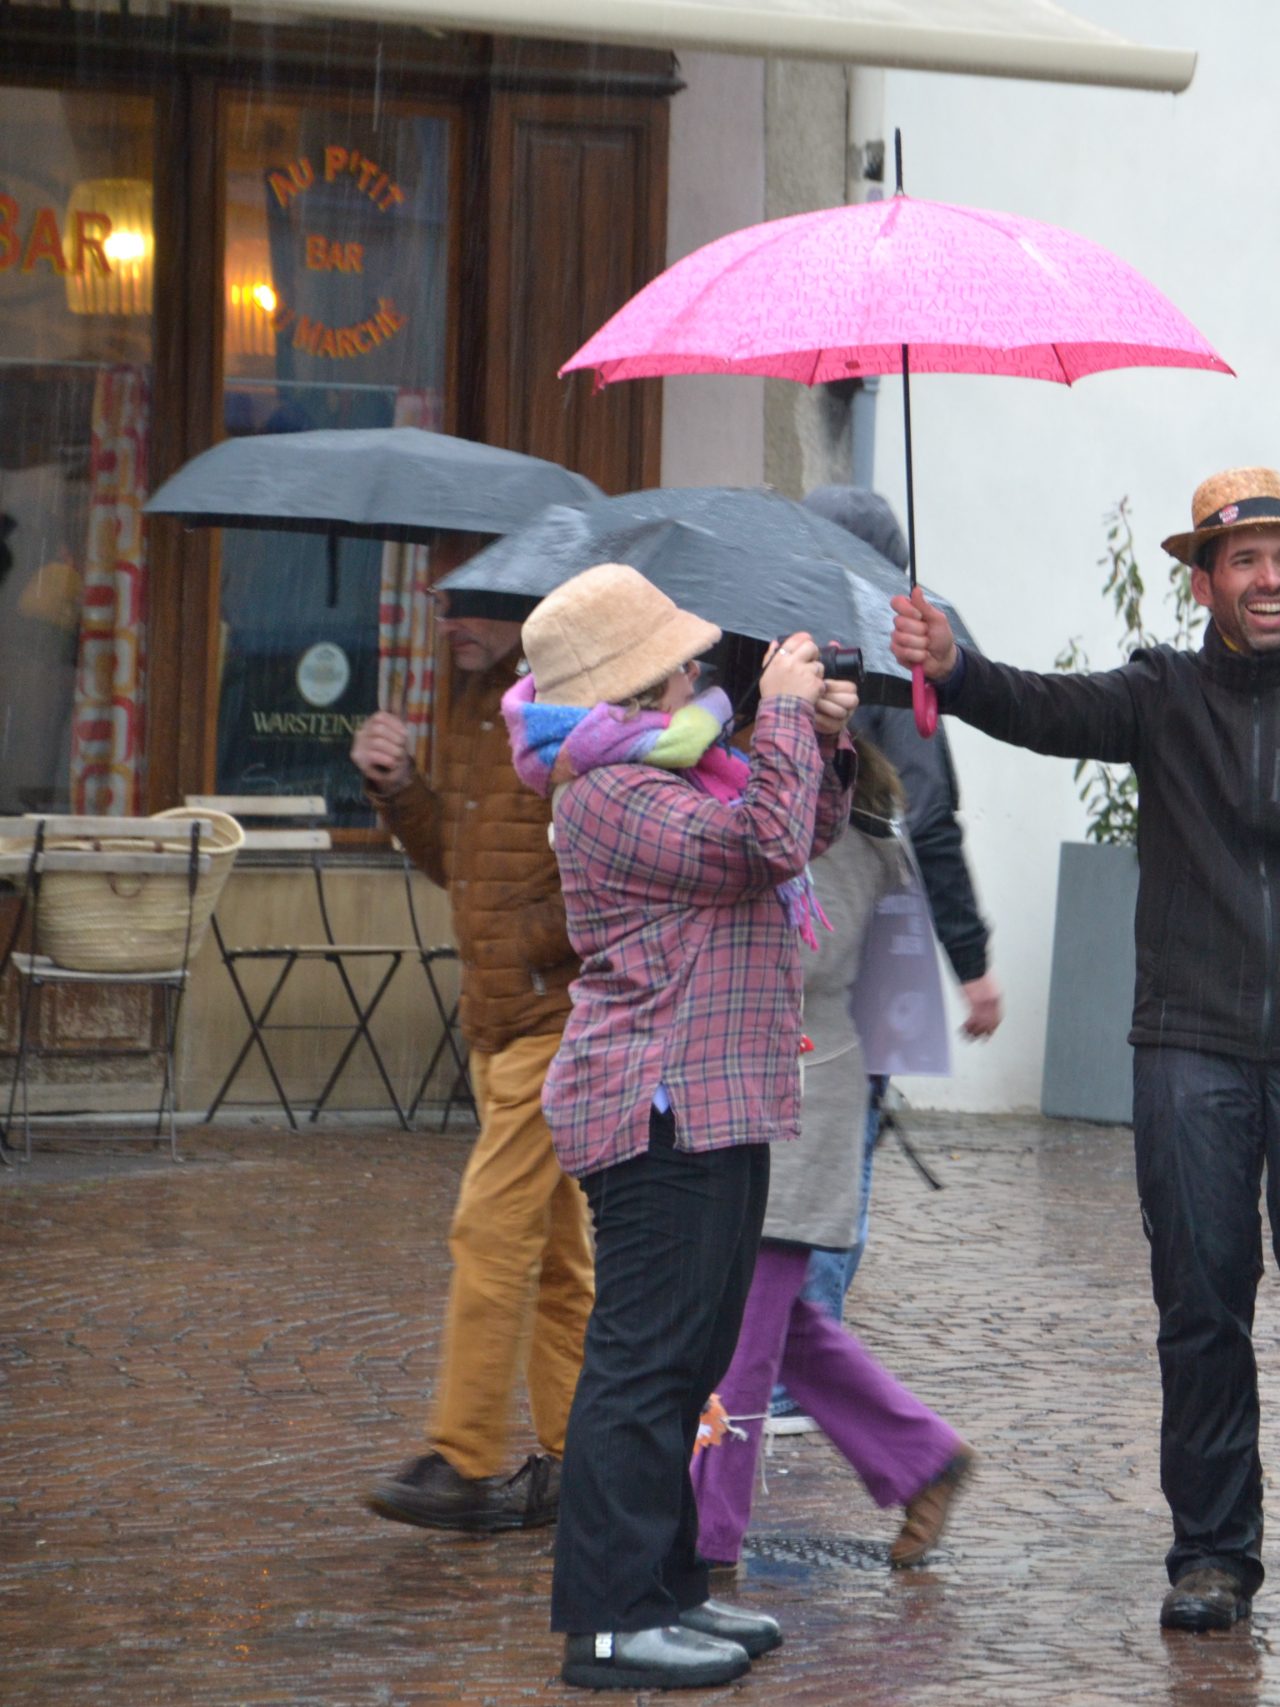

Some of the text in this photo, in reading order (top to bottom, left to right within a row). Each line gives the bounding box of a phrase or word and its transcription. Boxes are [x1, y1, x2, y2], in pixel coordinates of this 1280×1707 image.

[269, 157, 315, 208] AU
[305, 234, 364, 273] BAR
[252, 711, 367, 735] WARSTEINE
